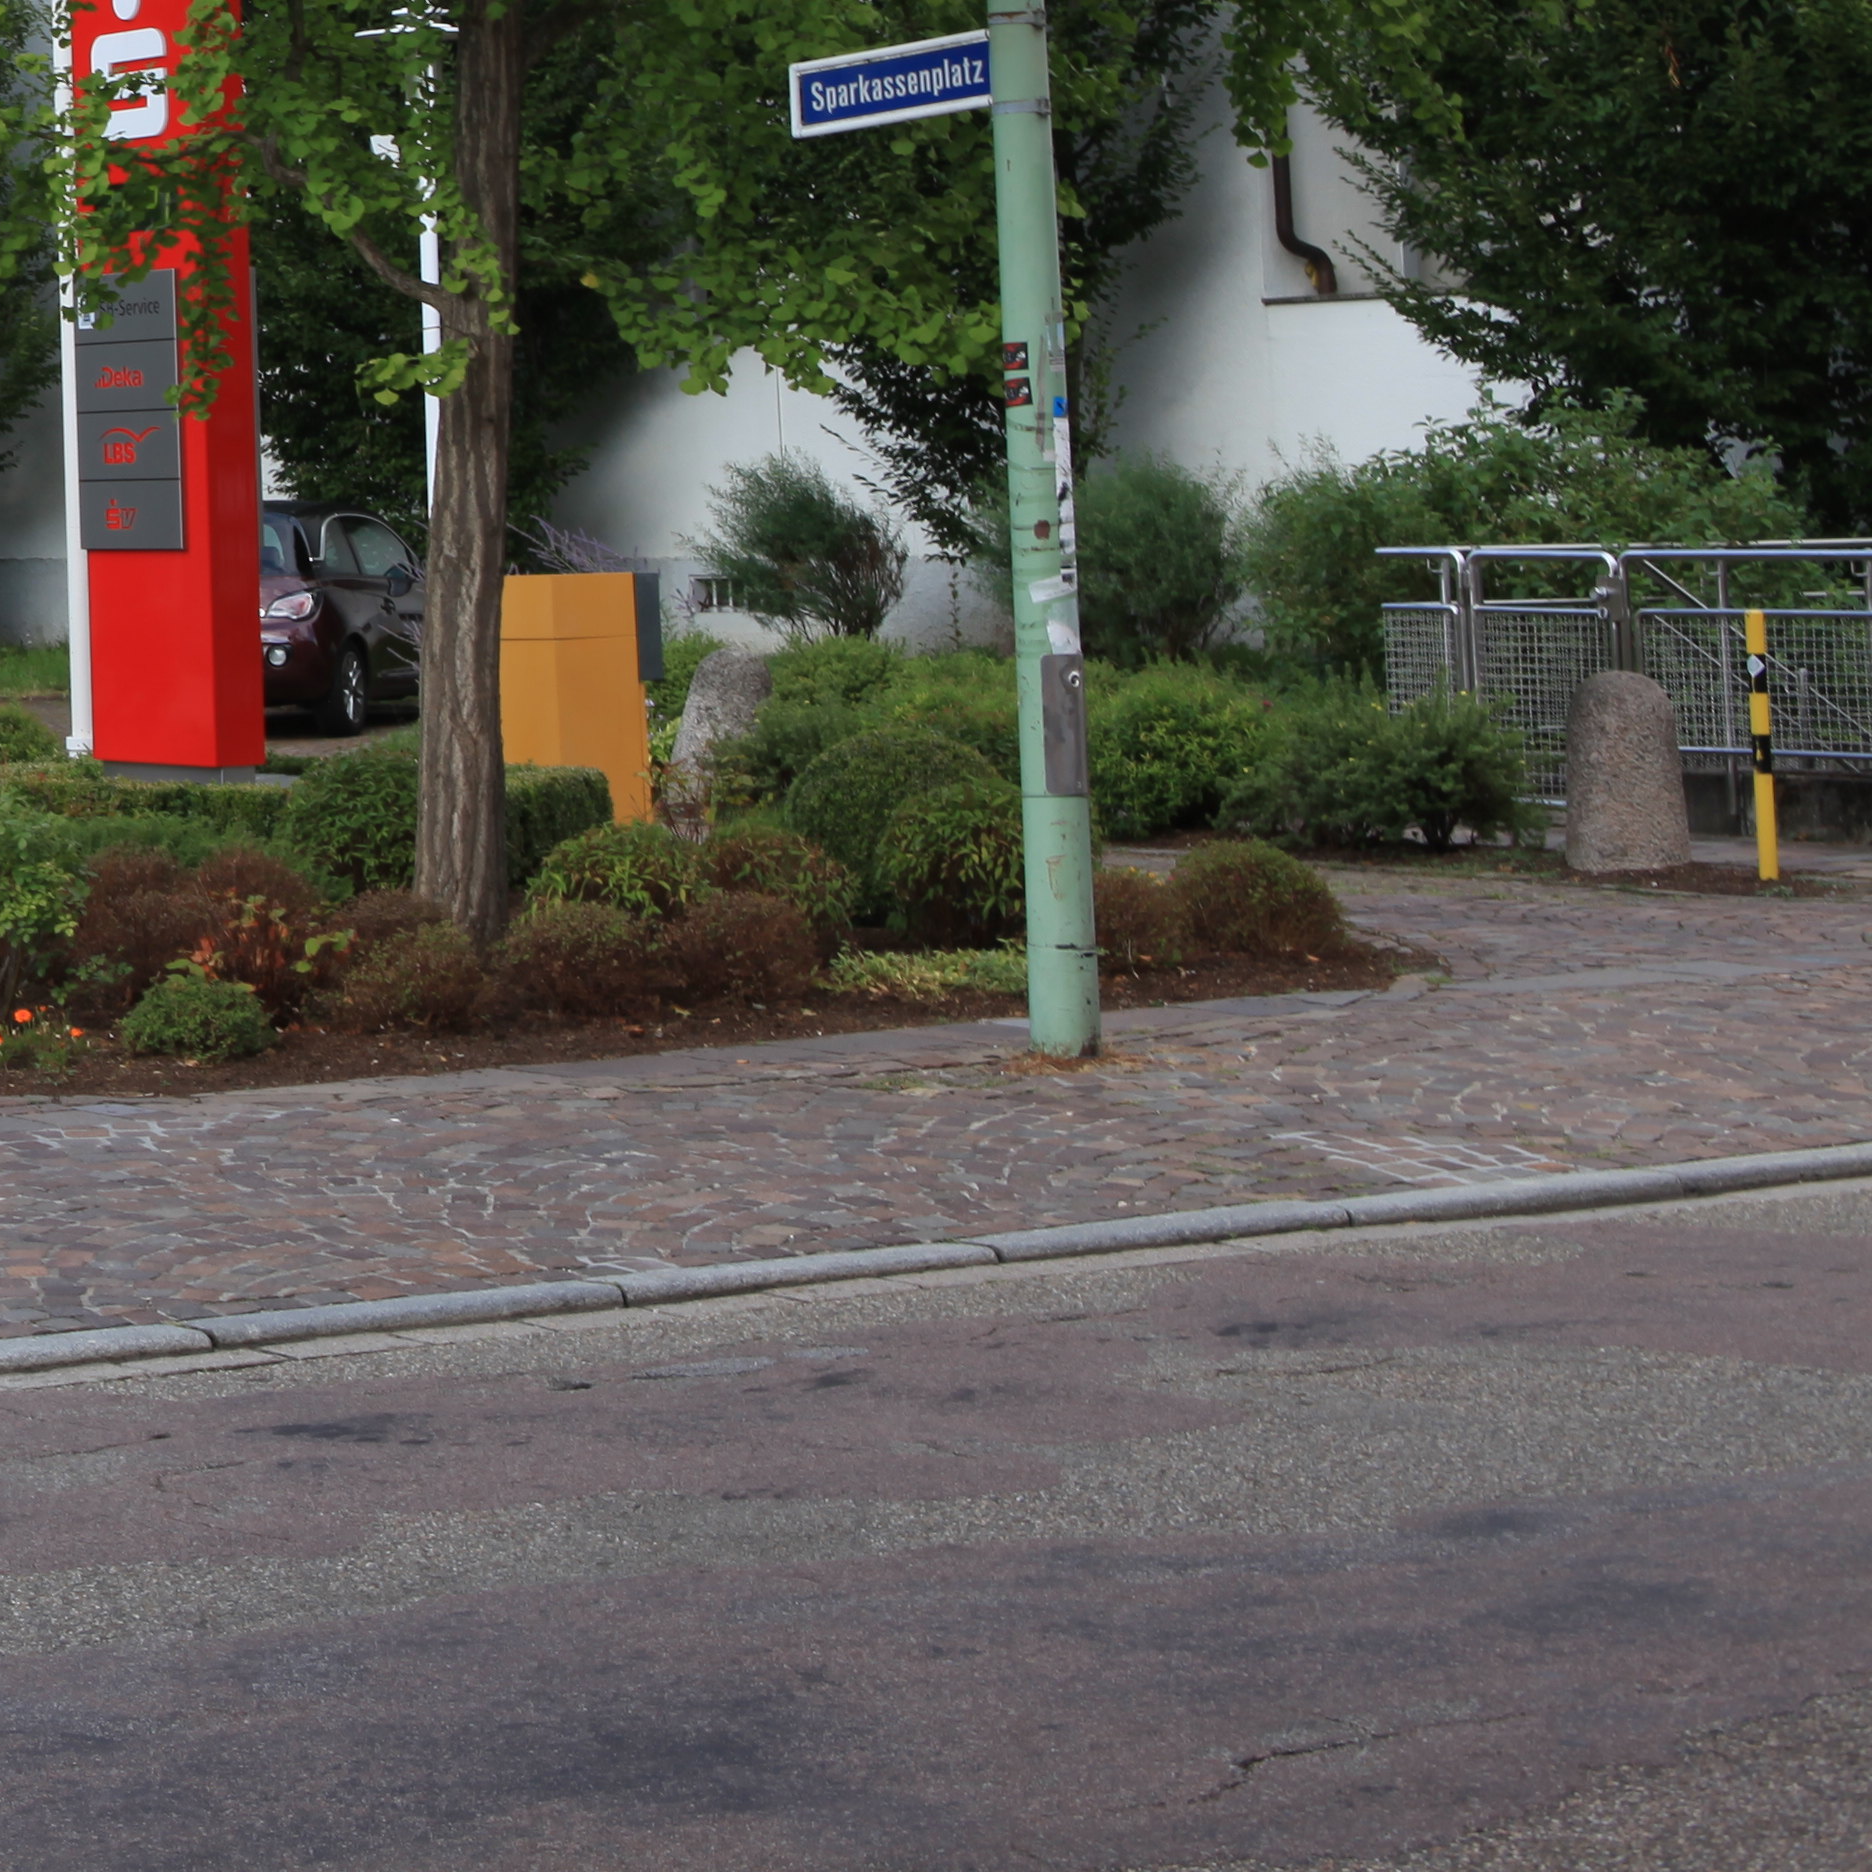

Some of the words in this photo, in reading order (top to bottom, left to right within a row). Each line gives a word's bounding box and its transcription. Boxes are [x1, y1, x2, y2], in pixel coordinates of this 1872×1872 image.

[810, 57, 985, 115] Sparkassenplatz
[94, 365, 145, 389] Deka
[103, 442, 137, 464] LBS
